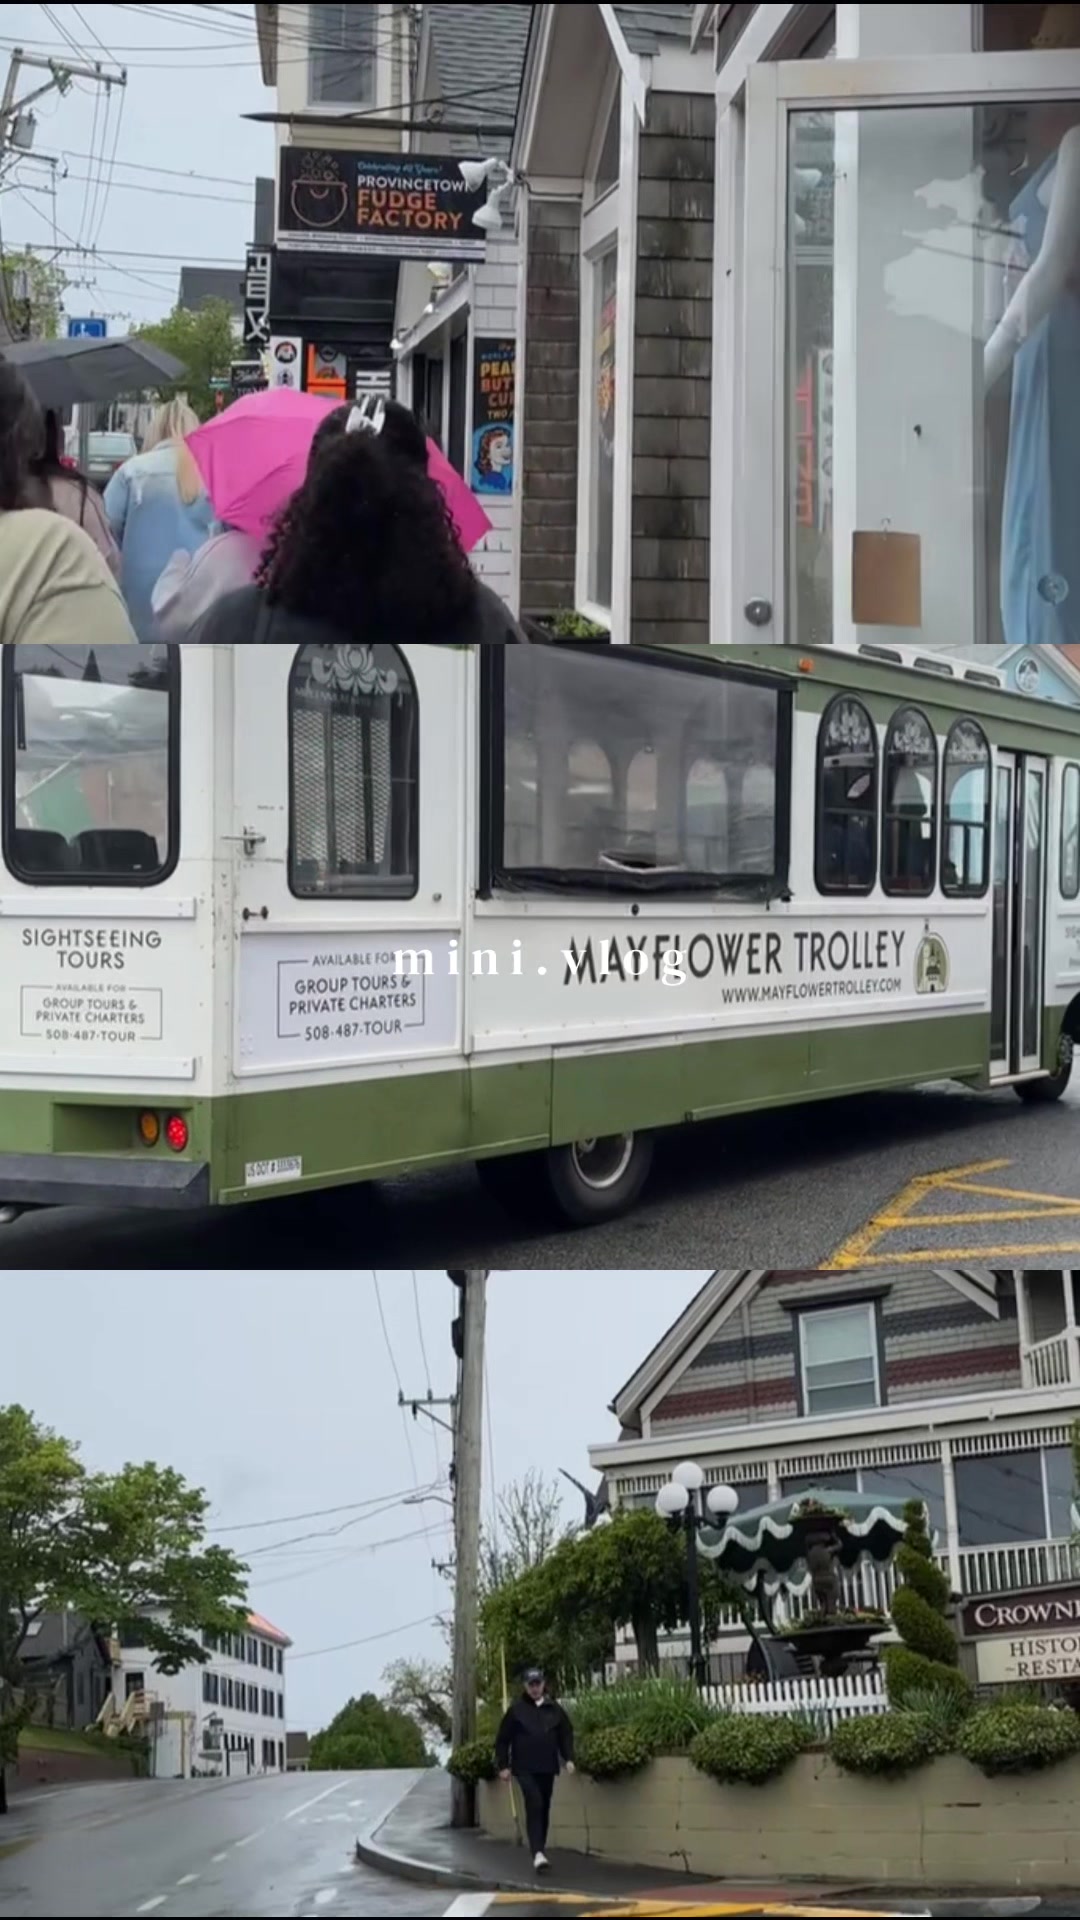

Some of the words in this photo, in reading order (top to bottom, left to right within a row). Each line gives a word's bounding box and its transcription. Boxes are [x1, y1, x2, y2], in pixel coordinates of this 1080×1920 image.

[358, 188, 437, 211] FUDGE
[357, 207, 463, 230] FACTORY
[480, 361, 515, 377] PEA
[480, 377, 513, 393] BUT
[22, 928, 162, 949] SIGHTSEEING
[57, 950, 125, 969] TOURS
[312, 953, 371, 967] AVAILABLE
[793, 930, 905, 973] TROLLEY
[55, 983, 104, 993] AVAILABLE
[107, 984, 127, 993] FOR
[294, 977, 348, 995] GROUP
[352, 974, 397, 991] TOURS
[401, 974, 412, 988] &
[722, 977, 902, 1004] WWW.MAYFLOWERTROLLEY.COM
[42, 997, 84, 1009] GROUP
[87, 998, 125, 1010] TOURS
[128, 998, 138, 1010] &
[289, 998, 345, 1015] PRIVATE
[349, 993, 417, 1011] CHARTERS
[36, 1010, 81, 1023] PRIVATE
[85, 1011, 145, 1024] CHARTERS
[1010, 1636, 1080, 1657] HISTO
